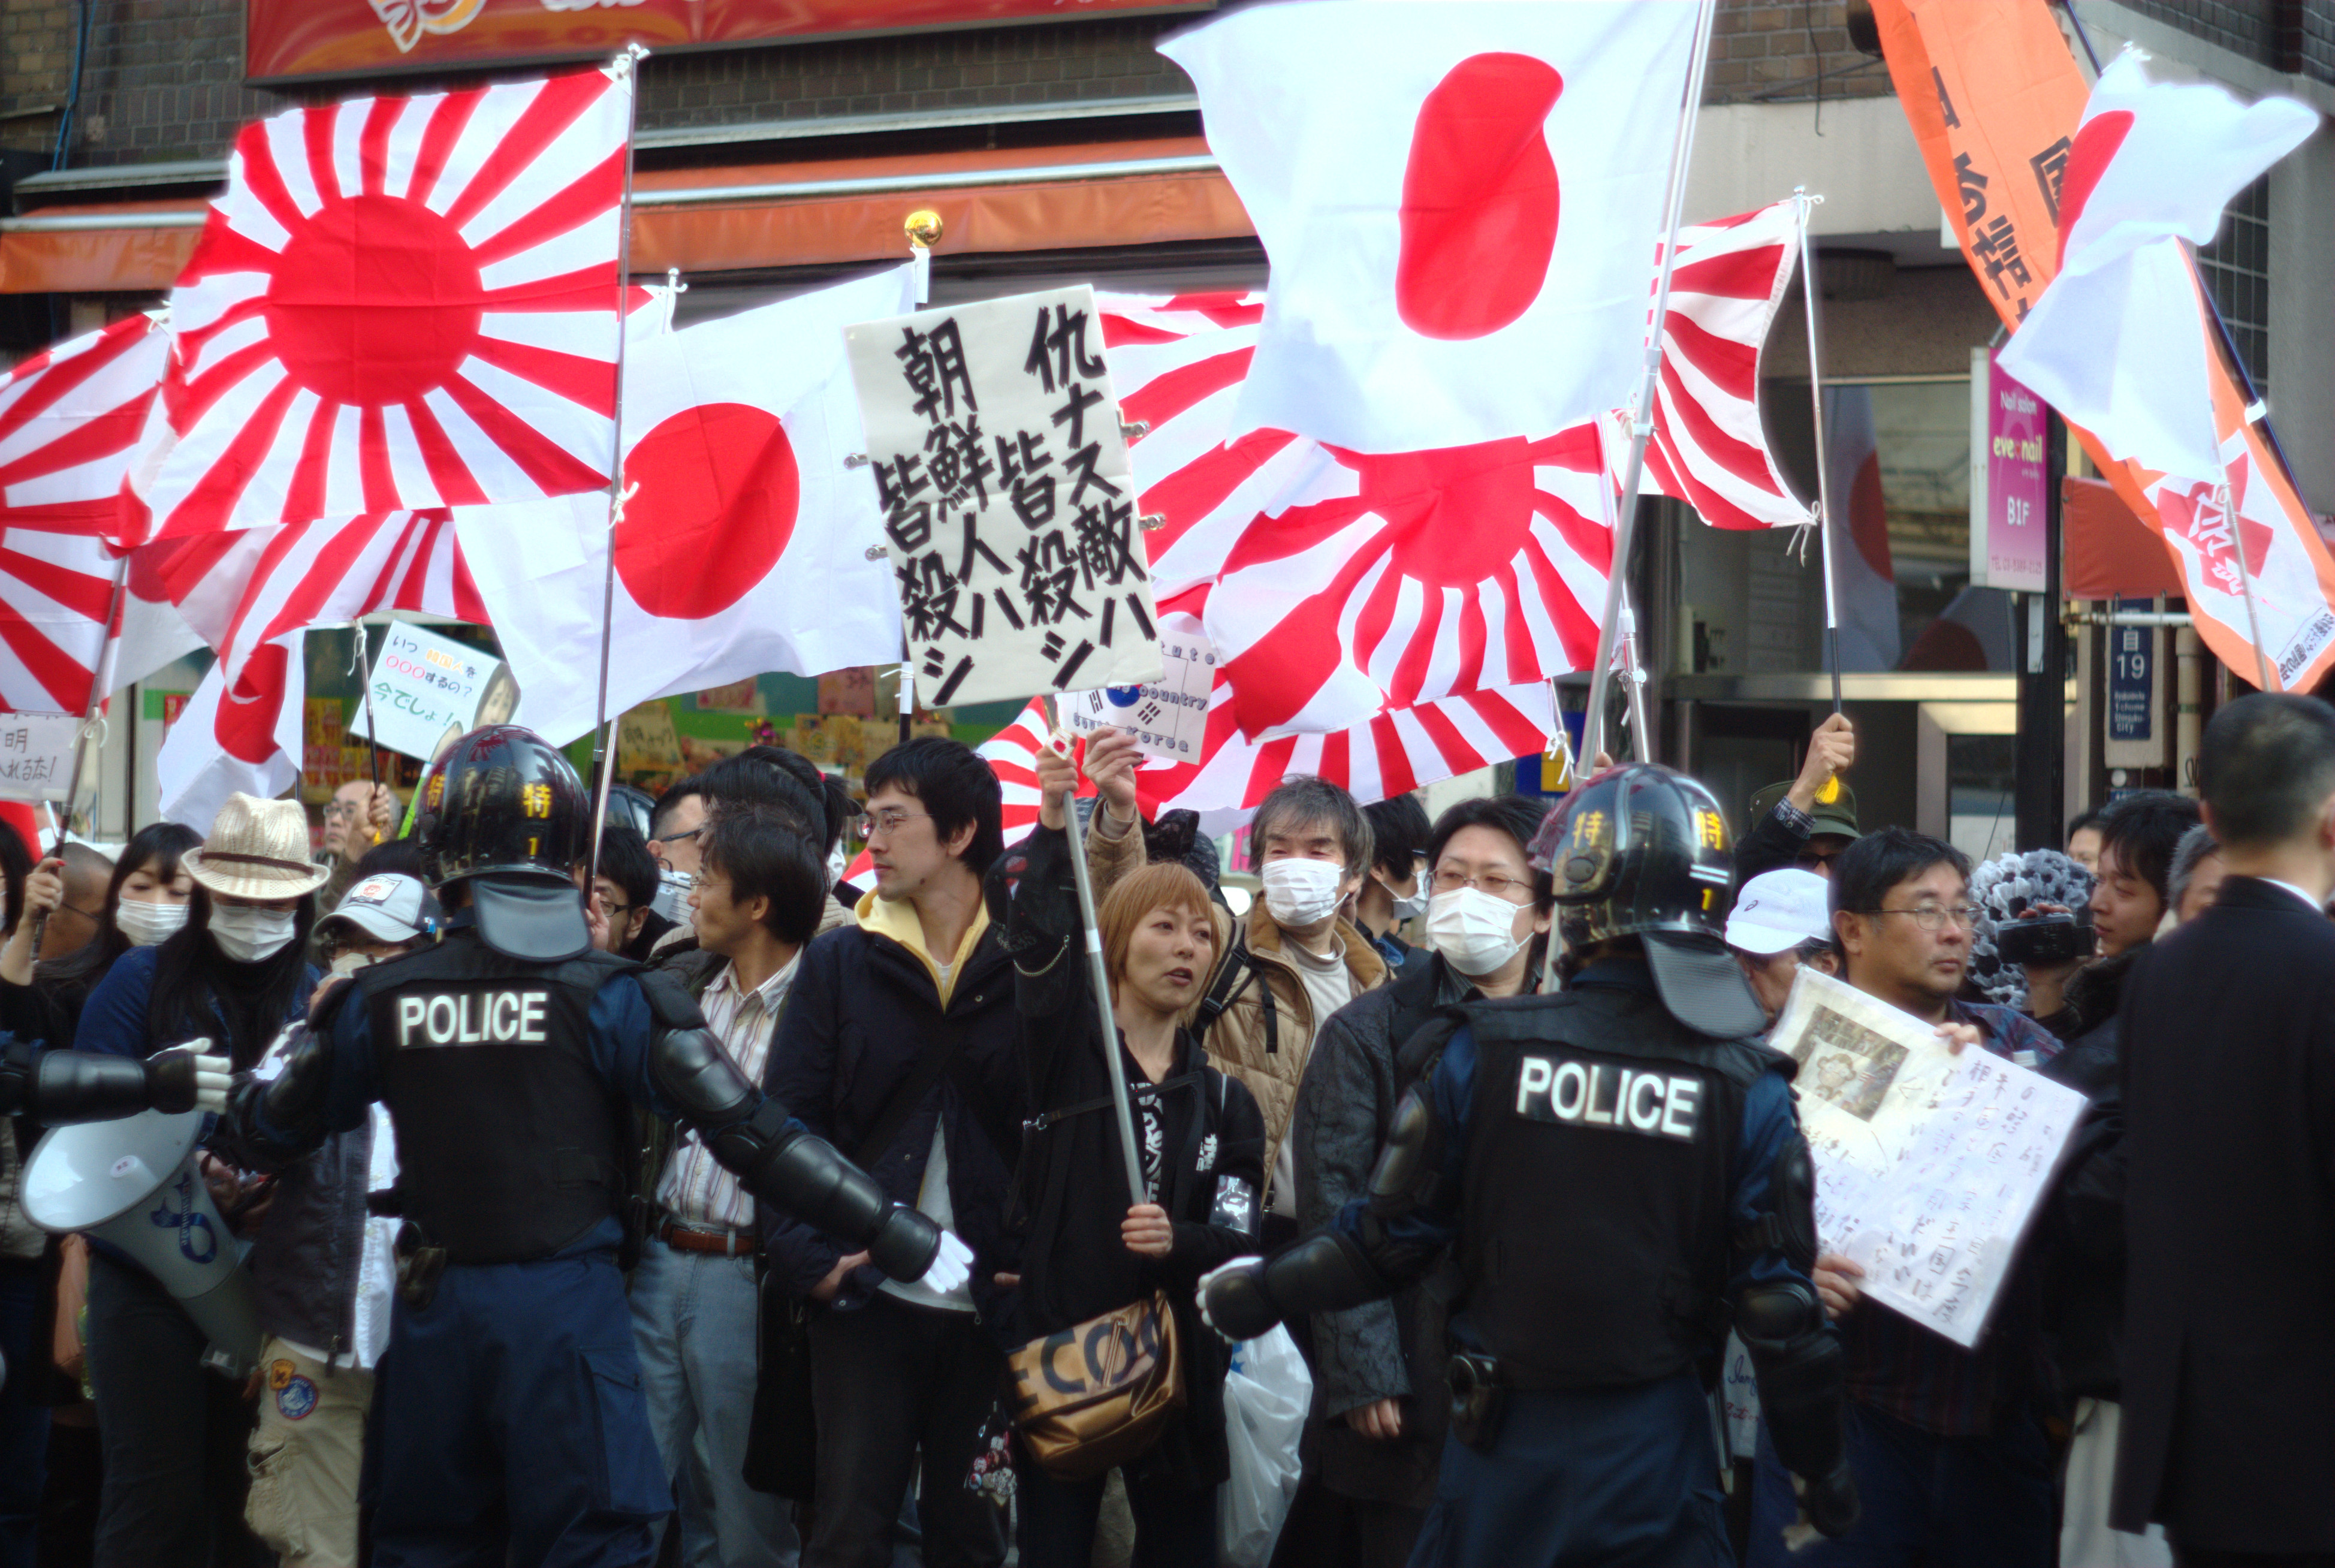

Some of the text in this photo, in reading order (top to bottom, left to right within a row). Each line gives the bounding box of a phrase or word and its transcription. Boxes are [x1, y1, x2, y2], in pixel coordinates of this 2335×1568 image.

[2000, 390, 2017, 412] Nail
[1993, 433, 2043, 463] eve nail
[894, 316, 1025, 640] 朝鮮人ハ
[1024, 303, 1157, 649] 仇ナス敵ハ
[2007, 496, 2030, 527] B1F
[995, 430, 1095, 690] 皆殺シ
[871, 453, 975, 706] 皆殺シ
[2116, 653, 2146, 680] 19
[1139, 686, 1207, 711] country
[1126, 726, 1189, 752] Korea
[523, 783, 551, 818] 特
[529, 837, 538, 855] 1
[1572, 810, 1604, 849] 特
[1695, 812, 1722, 850] 特
[1702, 888, 1713, 910] 1
[400, 992, 548, 1047] POLICE
[1516, 1056, 1700, 1138] POLICE
